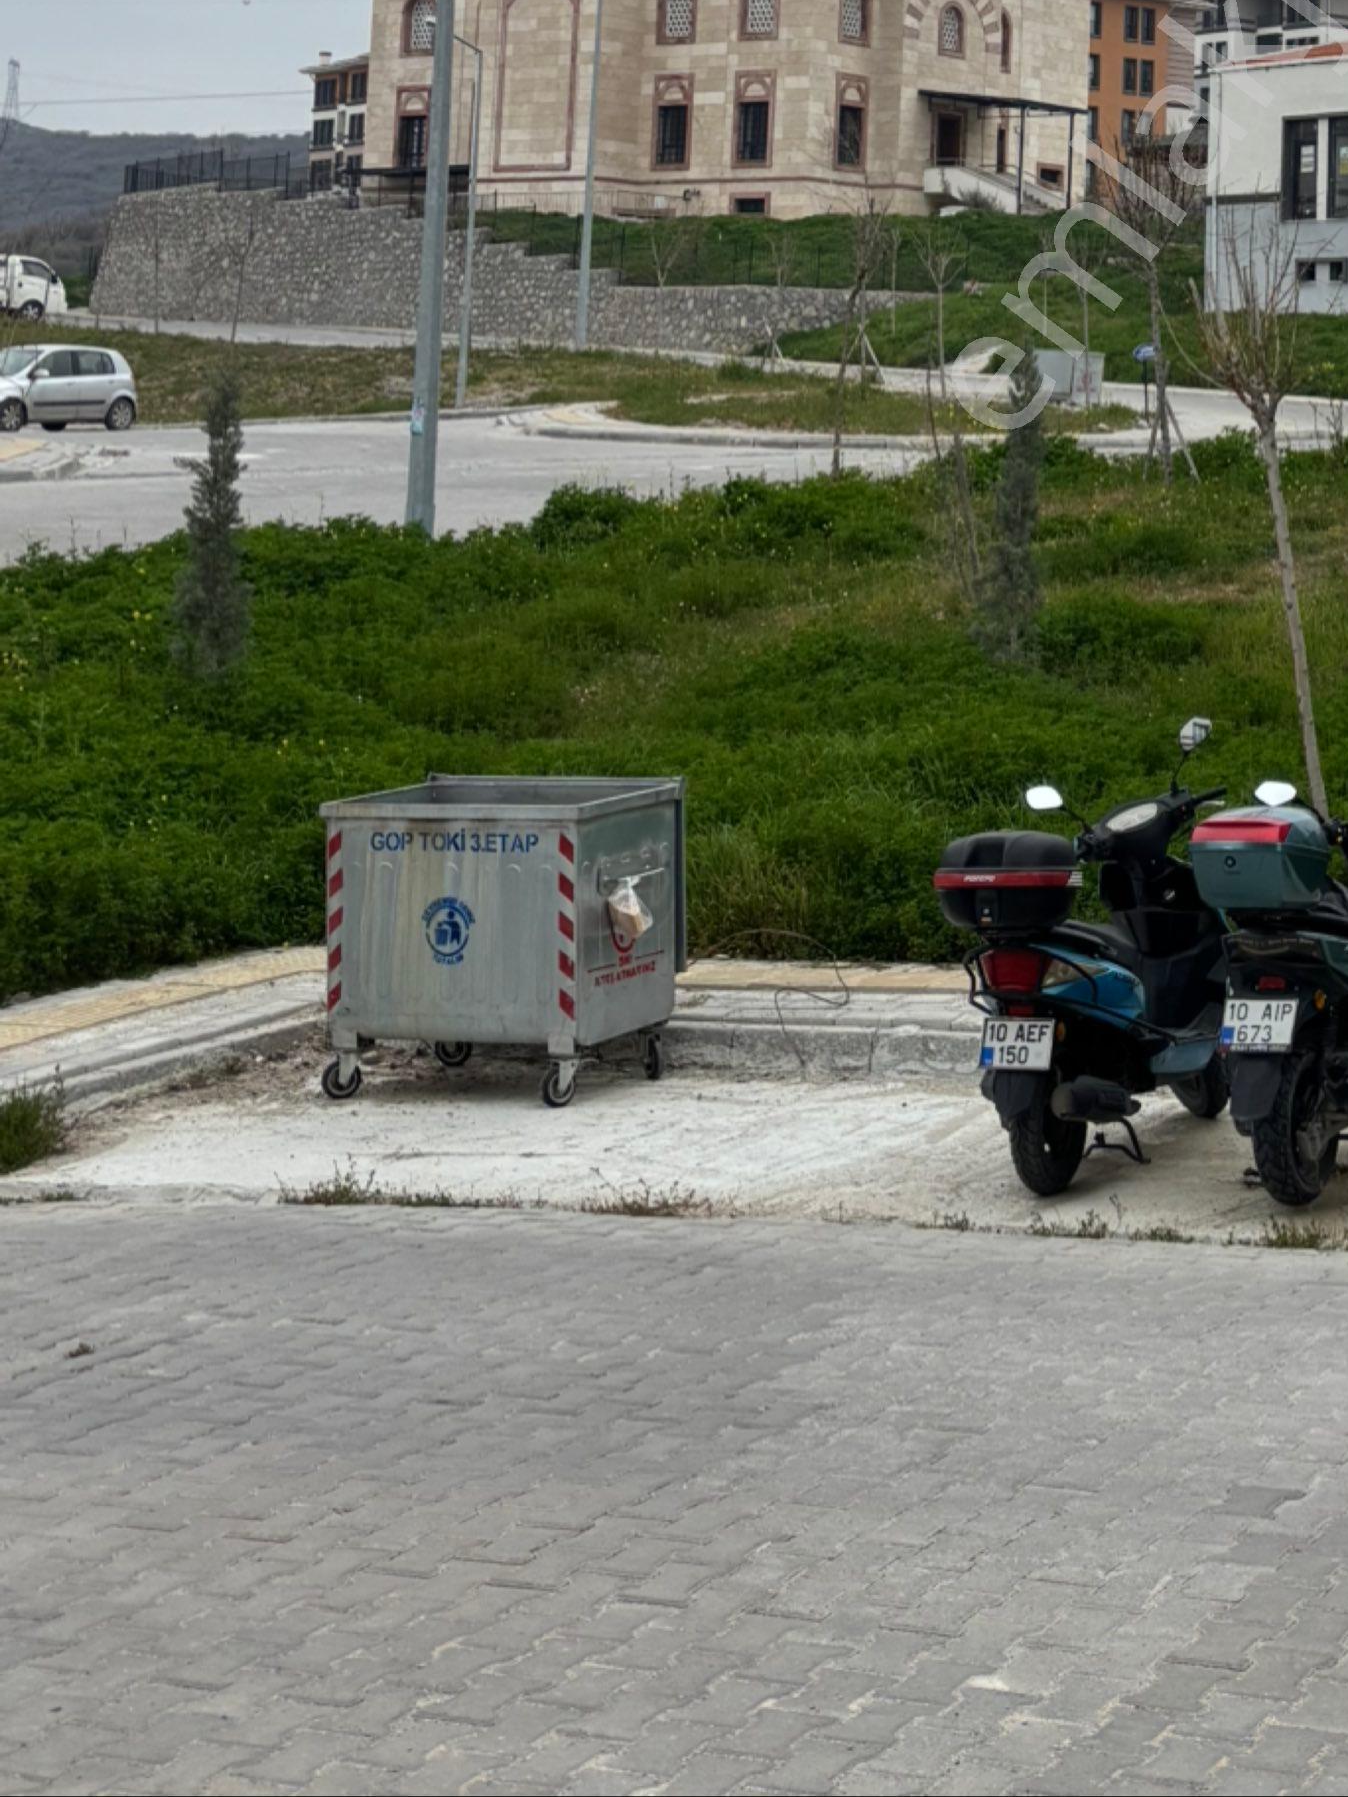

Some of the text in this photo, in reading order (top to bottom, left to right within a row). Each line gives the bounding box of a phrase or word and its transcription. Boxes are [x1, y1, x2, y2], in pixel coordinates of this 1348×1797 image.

[370, 831, 414, 852] GOP
[418, 828, 466, 852] TOKİ
[1229, 1003, 1293, 1021] 10 AIP
[988, 1023, 1050, 1043] 10 AEF
[1237, 1025, 1272, 1042] 673
[998, 1045, 1030, 1064] 150
